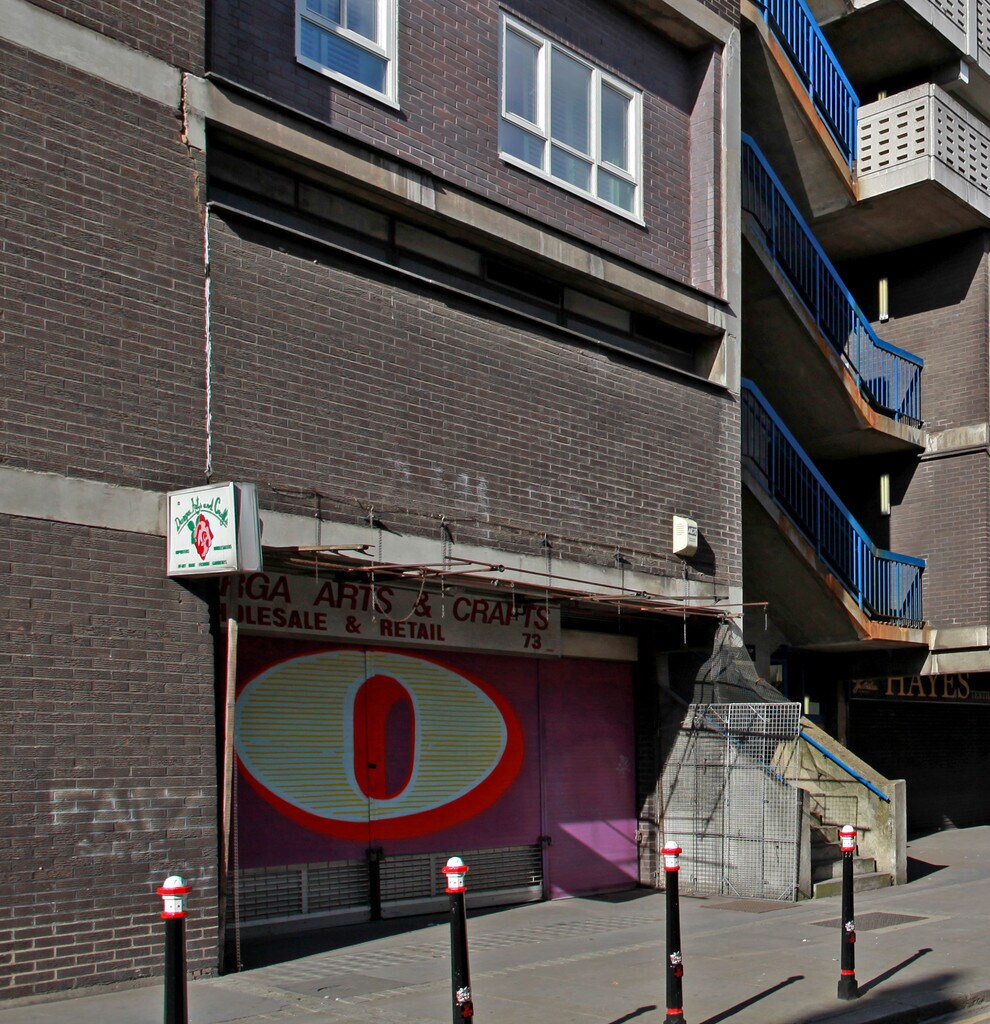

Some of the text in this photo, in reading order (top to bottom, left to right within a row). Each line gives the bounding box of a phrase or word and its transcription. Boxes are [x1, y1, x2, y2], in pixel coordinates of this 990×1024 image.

[203, 497, 214, 511] and
[313, 581, 394, 614] ARTS
[414, 592, 432, 618] &
[453, 597, 550, 631] CRAFTS
[346, 616, 361, 634] &
[380, 619, 445, 642] RETAIL
[522, 633, 542, 650] 73
[885, 673, 970, 699] HAYES
